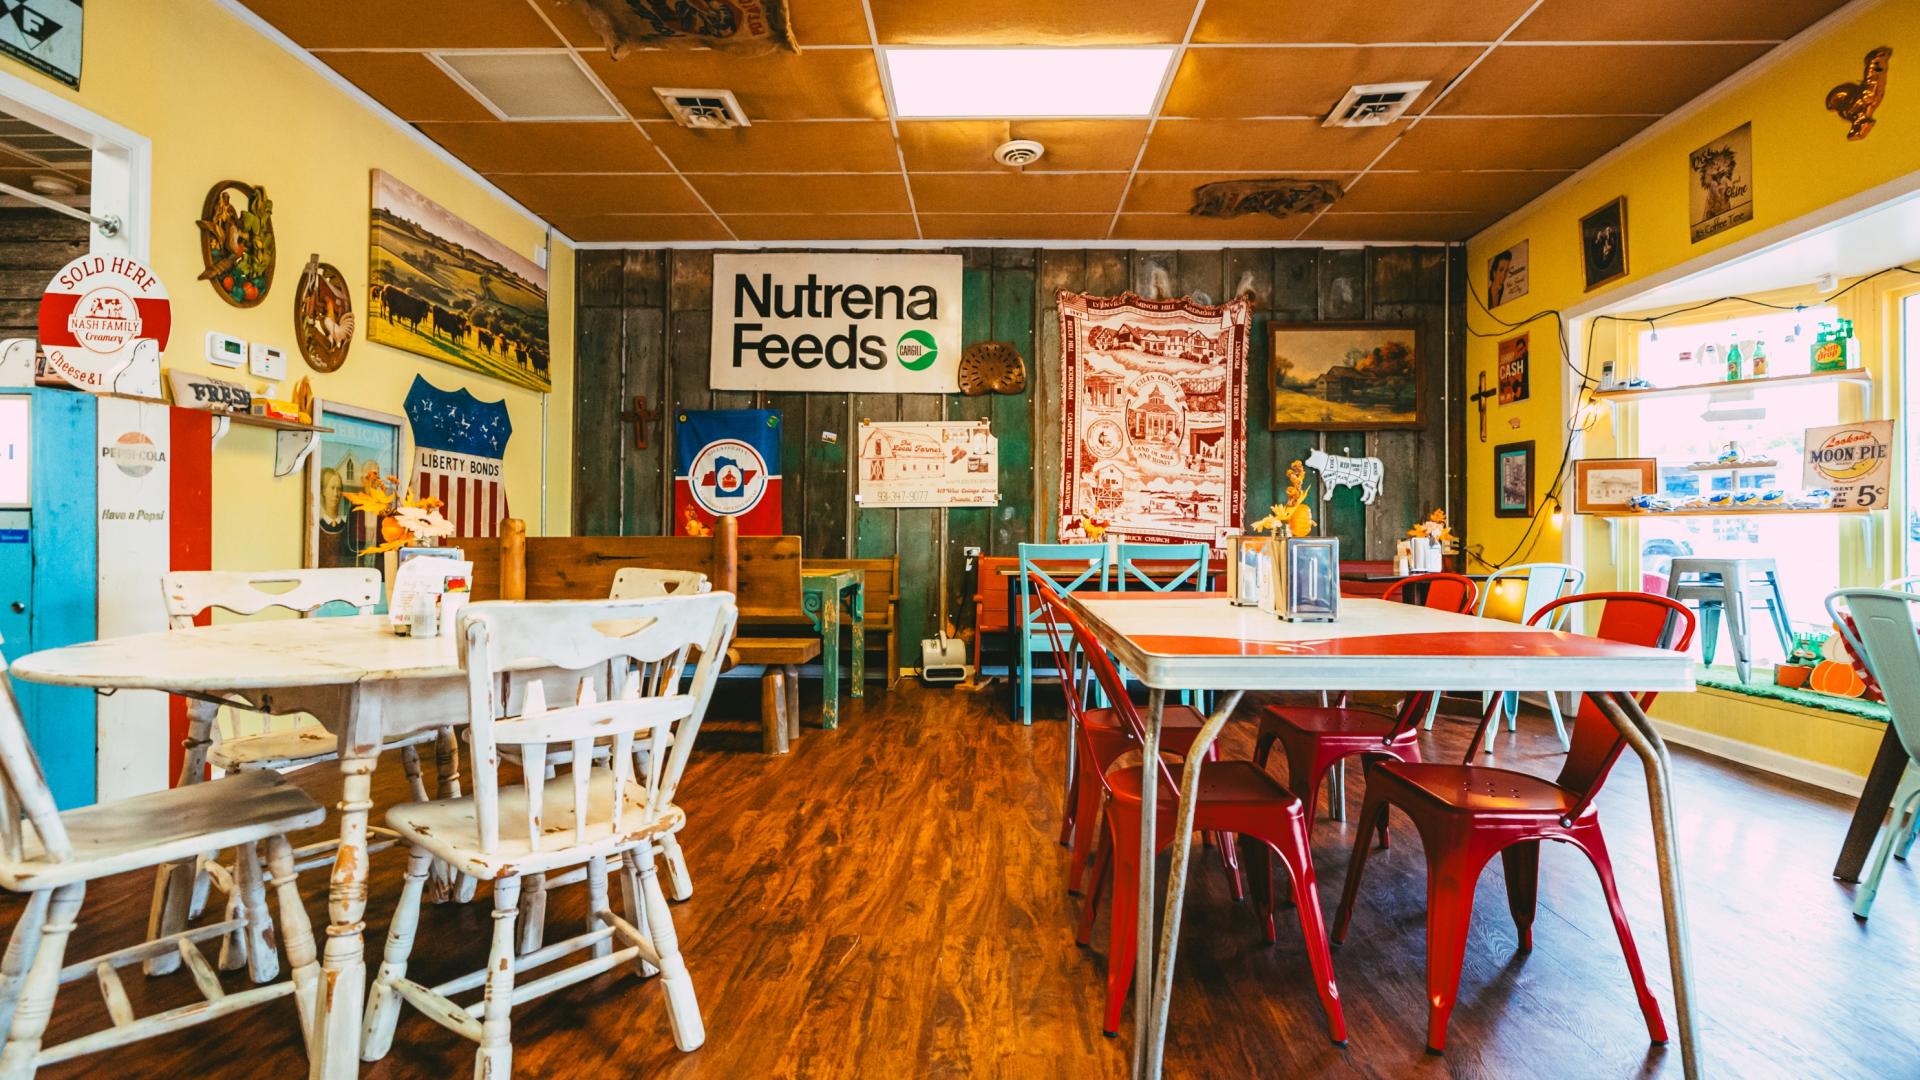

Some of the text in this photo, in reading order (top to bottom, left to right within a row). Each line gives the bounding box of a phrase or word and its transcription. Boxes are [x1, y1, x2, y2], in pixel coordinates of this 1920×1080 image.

[60, 256, 156, 292] SOLD HERE
[734, 274, 938, 320] Nutrena
[71, 319, 139, 332] NASH FAMILY
[85, 332, 123, 344] Creamery
[732, 323, 888, 370] Feeds
[899, 345, 922, 356] CARGILL
[50, 350, 87, 382] Cheese
[87, 372, 95, 385] &
[1500, 360, 1524, 380] CASH
[1826, 432, 1872, 448] Lookout
[1810, 444, 1887, 463] MOON PIE
[421, 452, 500, 476] LIBERTY BONDS
[102, 510, 126, 520] Have
[136, 510, 165, 522] Pepsi
[1144, 535, 1170, 544] CHURCH
